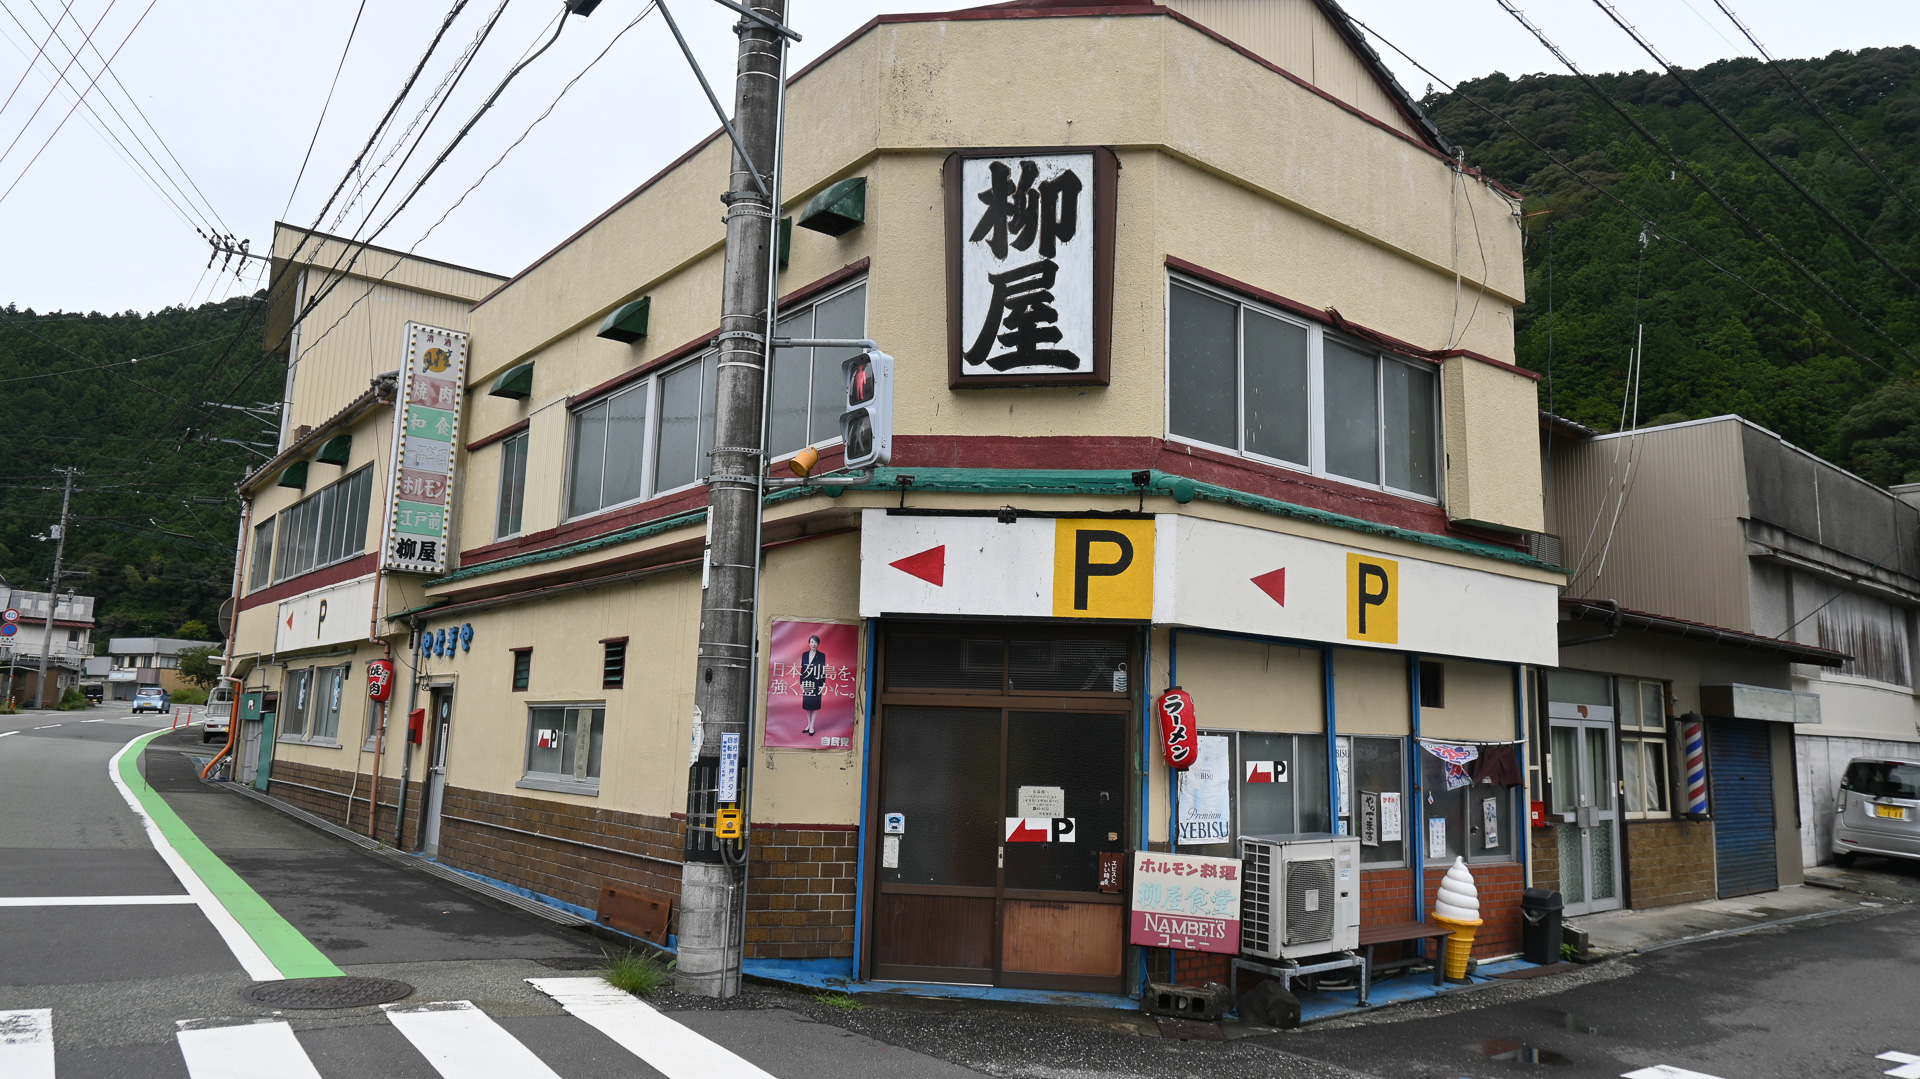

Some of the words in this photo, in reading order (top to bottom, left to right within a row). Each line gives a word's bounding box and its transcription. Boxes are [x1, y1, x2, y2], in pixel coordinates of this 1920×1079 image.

[963, 160, 1083, 372] 柳屋
[412, 380, 454, 405] 焼肉
[410, 413, 450, 436] 和食
[406, 445, 449, 466] 一品料理
[403, 476, 444, 498] ホルモン
[400, 510, 442, 530] 江戸前
[396, 538, 437, 563] 柳屋
[1074, 529, 1134, 610] P
[1357, 562, 1389, 634] P
[317, 597, 328, 641] P
[369, 663, 384, 695] 焼肉
[773, 661, 856, 682] 日本列島を、
[770, 678, 856, 699] 強く豊かに。
[550, 729, 557, 748] P
[1164, 694, 1190, 762] ラーメン
[820, 736, 850, 747] 自民党
[1273, 761, 1286, 782] P
[1186, 807, 1222, 821] Premium
[1365, 796, 1375, 842] やってます
[1052, 818, 1074, 842] P
[1179, 821, 1230, 839] YEBISU
[1139, 858, 1238, 880] ホルモン料理
[1137, 880, 1237, 918] 柳屋食堂
[1158, 934, 1210, 949] コーヒー
